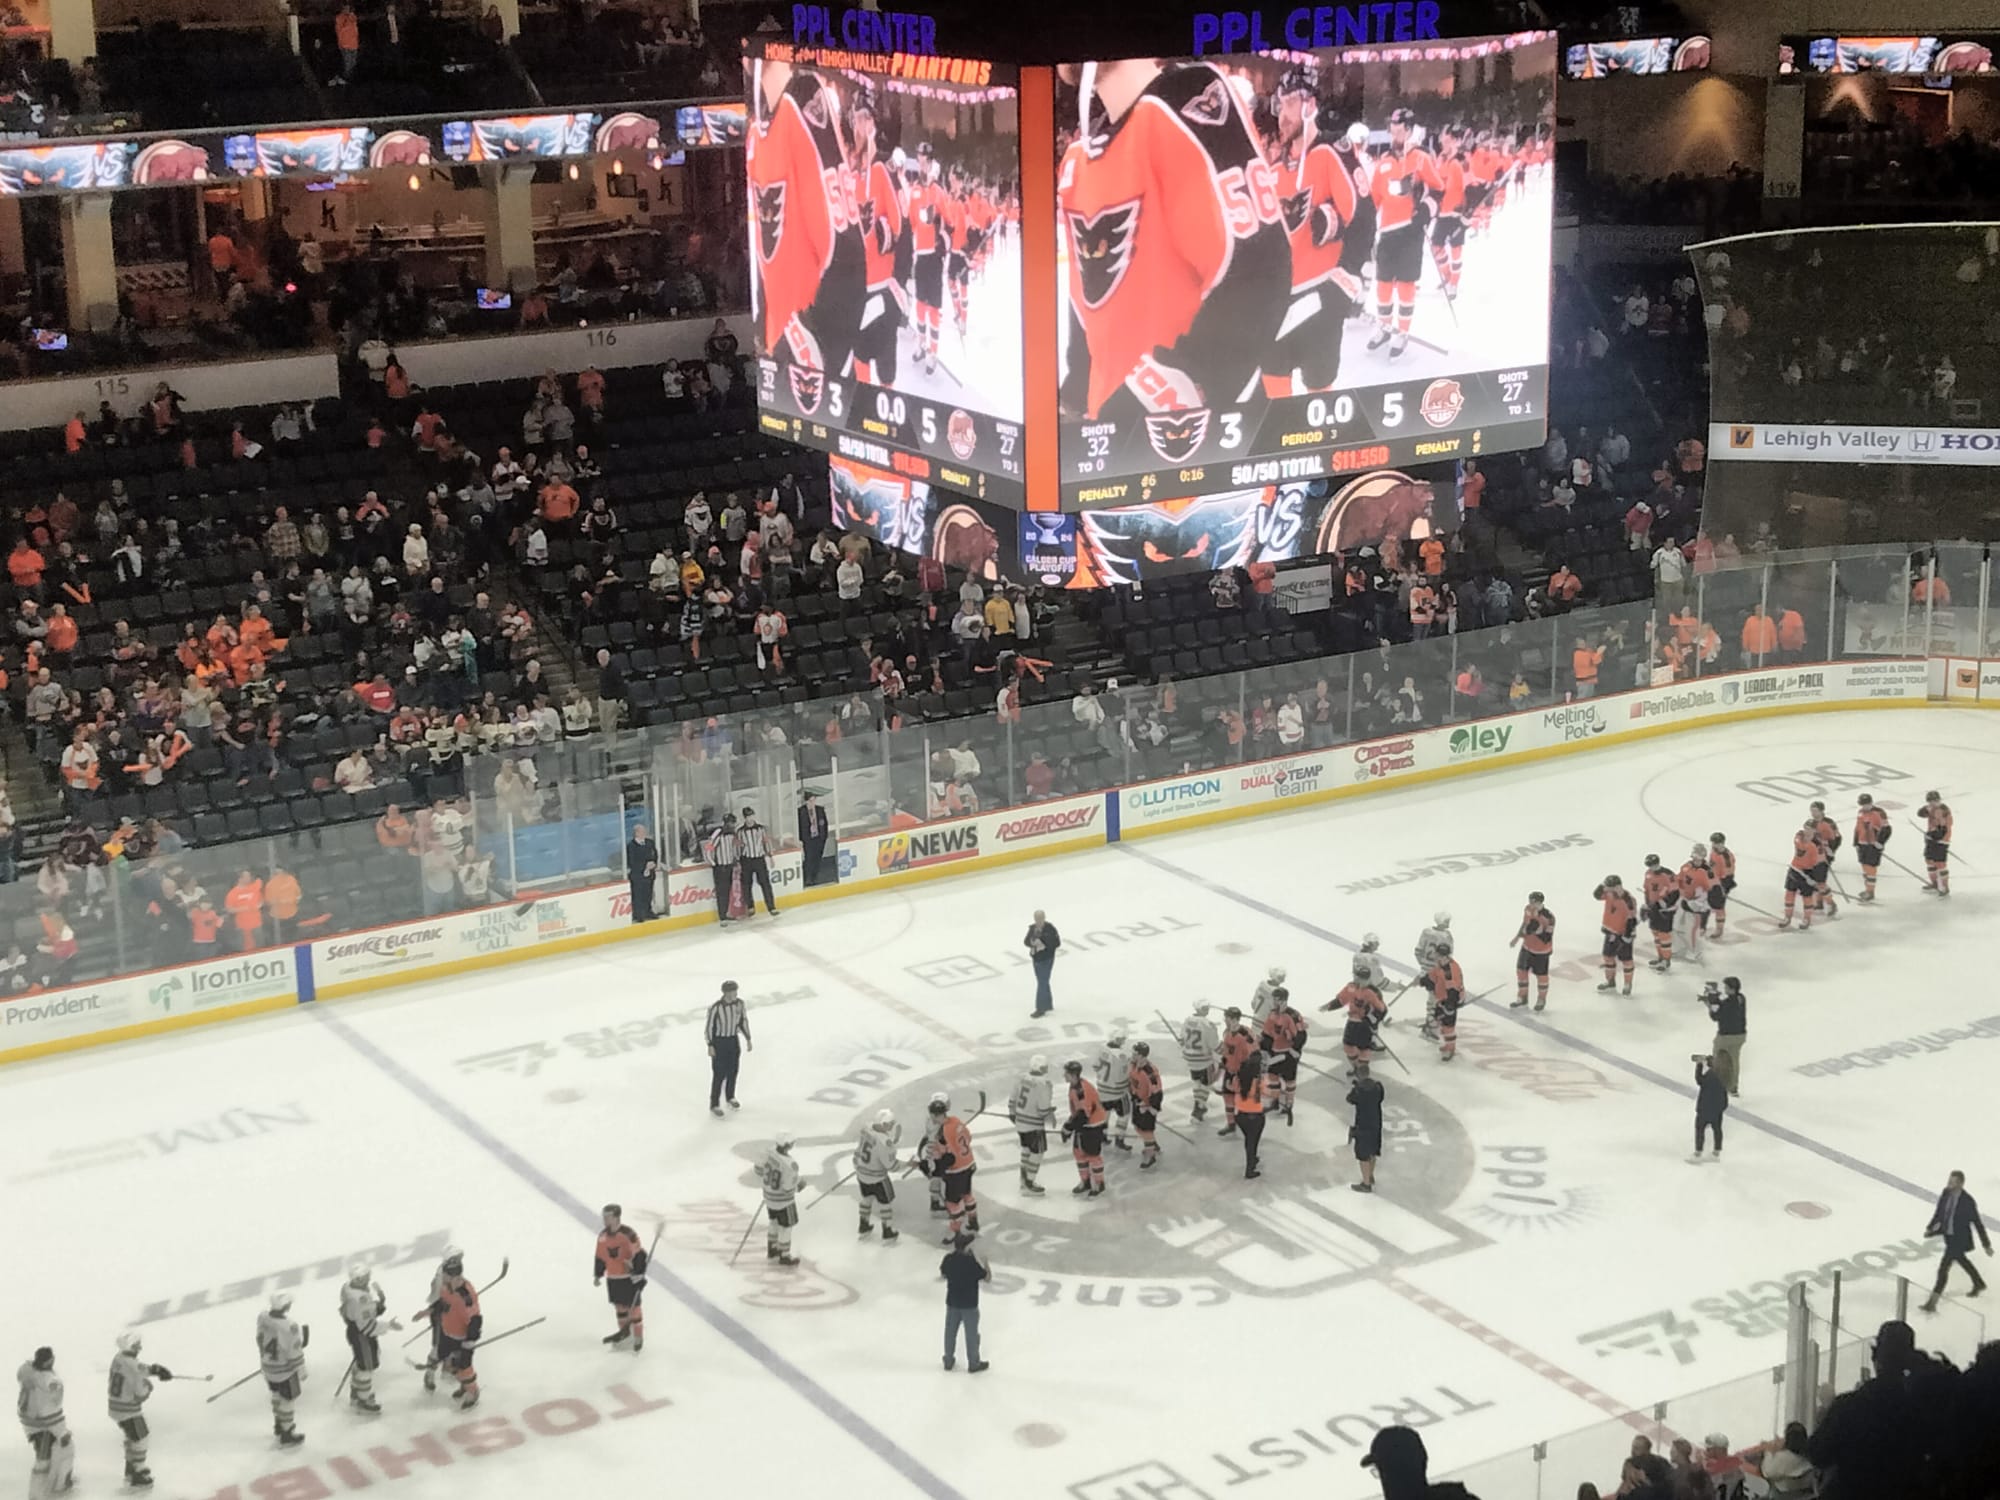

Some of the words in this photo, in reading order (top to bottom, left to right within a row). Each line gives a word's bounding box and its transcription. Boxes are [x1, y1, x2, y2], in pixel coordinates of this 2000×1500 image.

[792, 3, 836, 46] PPL
[842, 9, 937, 55] CENTER
[1192, 11, 1270, 56] PPL
[1285, 1, 1440, 51] CENTER
[765, 42, 794, 63] HOME
[816, 49, 851, 70] LEHIGH
[852, 54, 890, 74] VALLEY
[891, 52, 1002, 86] PHANTOMS
[1907, 42, 1934, 69] VS
[563, 121, 591, 147] VS
[338, 136, 364, 163] VS
[92, 149, 125, 180] VS
[587, 329, 617, 347] 116
[94, 377, 129, 396] 115
[762, 370, 776, 389] 32
[1495, 370, 1529, 384] SHOTS
[829, 382, 843, 417] 3
[1502, 383, 1523, 402] 27
[876, 392, 906, 425] 0.0
[1306, 394, 1354, 428] 0.0
[1382, 393, 1404, 428] 5
[1508, 404, 1522, 416] TO
[1525, 401, 1532, 415] 1
[863, 418, 888, 436] PERIOD
[922, 408, 937, 443] 5
[996, 421, 1019, 439] SHOTS
[1081, 423, 1117, 438] SHOTS
[1219, 412, 1243, 449] 3
[1281, 430, 1324, 447] PERIOD
[1330, 430, 1338, 440] 3
[1000, 435, 1016, 456] 27
[1087, 437, 1110, 457] 32
[1416, 439, 1461, 456] PENALTY
[1763, 430, 1832, 452] Lehigh
[1838, 430, 1901, 453] Valley
[941, 466, 971, 488] PENALTY
[1002, 459, 1012, 471] TO
[1078, 463, 1093, 473] TO
[1096, 460, 1105, 472] 0
[1232, 460, 1277, 486] 50/50
[1281, 455, 1324, 477] TOTAL
[1078, 485, 1128, 502] PENALTY
[1180, 469, 1205, 482] 0:16
[901, 498, 928, 546] VS
[1256, 489, 1303, 552] VS
[1028, 562, 1075, 574] PLAYOFFS
[1743, 676, 1777, 695] LEADER
[1798, 672, 1824, 689] PACK
[1870, 687, 1893, 697] JUNE
[1641, 689, 1717, 718] PenTeleData
[1543, 704, 1597, 730] Melting
[1564, 722, 1589, 741] Pot
[1240, 775, 1275, 791] DUAL
[1287, 763, 1324, 784] TEMP
[1252, 764, 1268, 777] on
[1269, 759, 1297, 776] your
[1143, 779, 1221, 806] LUTRON
[1273, 777, 1319, 799] team
[1143, 807, 1160, 818] Light
[877, 833, 910, 869] 69
[911, 825, 979, 859] NEWS
[385, 927, 444, 950] ELECTRIC
[460, 917, 529, 943] MORNING
[1003, 915, 1203, 968] TRUIT
[475, 935, 514, 953] CALL
[190, 958, 286, 993] Ironton
[6, 993, 101, 1026] Provident
[805, 1053, 913, 1108] ppl
[1478, 1144, 1559, 1207] ppl
[980, 1270, 1232, 1308] cente
[1210, 1385, 1497, 1487] TRUIST
